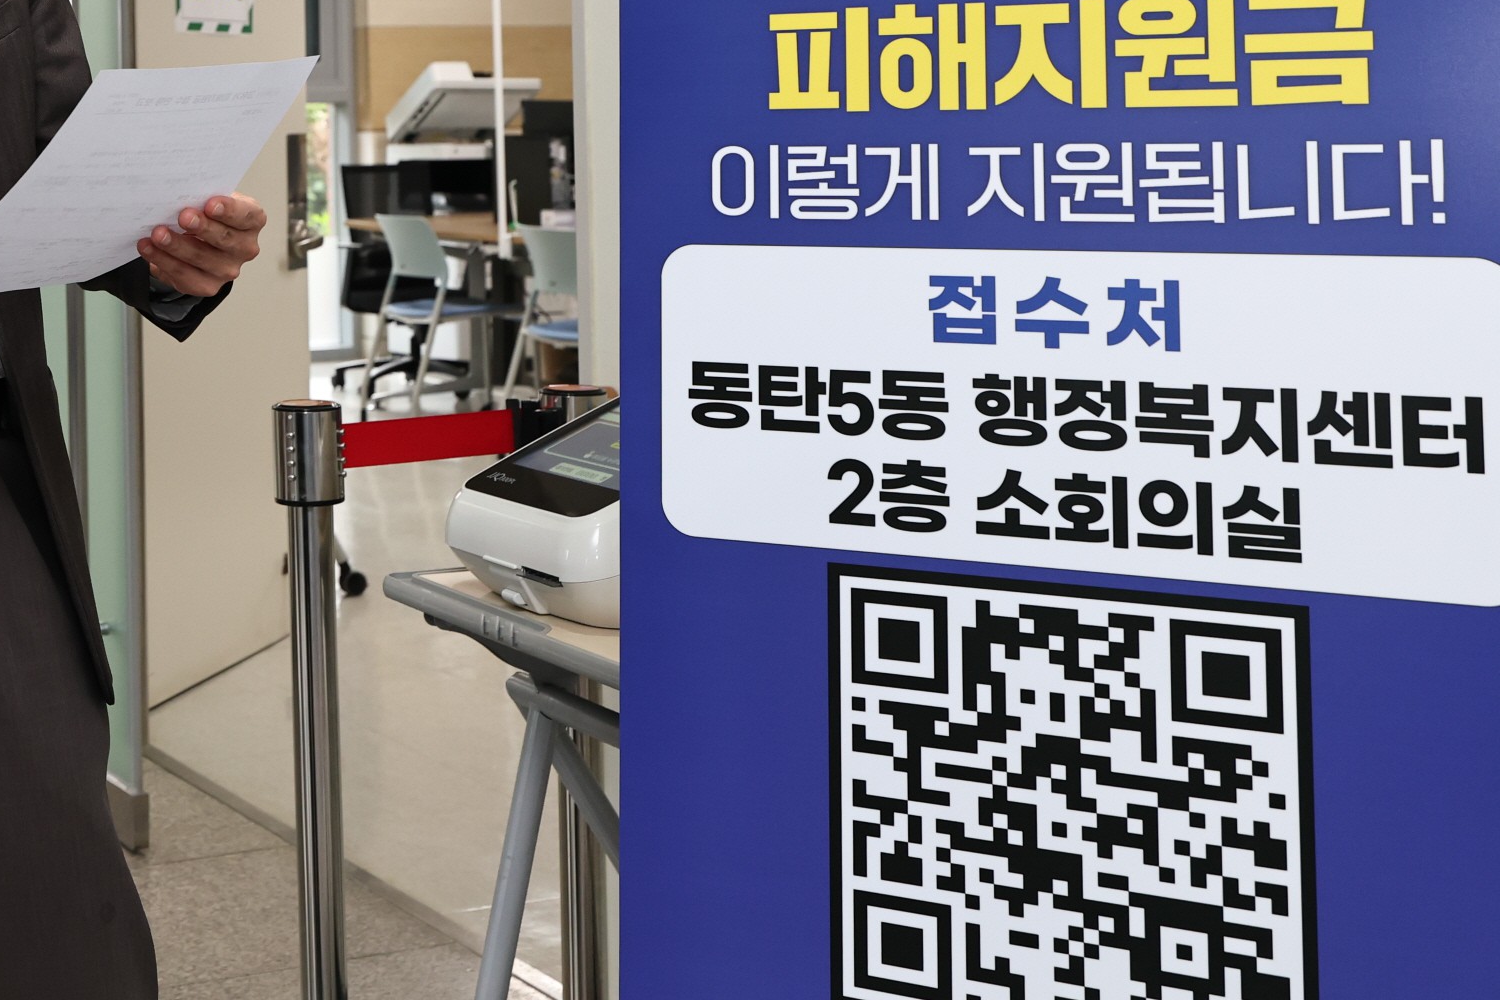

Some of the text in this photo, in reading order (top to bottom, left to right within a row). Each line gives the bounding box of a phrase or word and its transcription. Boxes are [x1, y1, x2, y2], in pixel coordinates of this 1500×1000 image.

[712, 139, 1445, 225] 이렇게 지원됩니다!
[929, 275, 1180, 352] 접수처
[689, 361, 1485, 474] 동탄5동 행정복지센터
[828, 459, 1302, 563] 2층 소회의실
